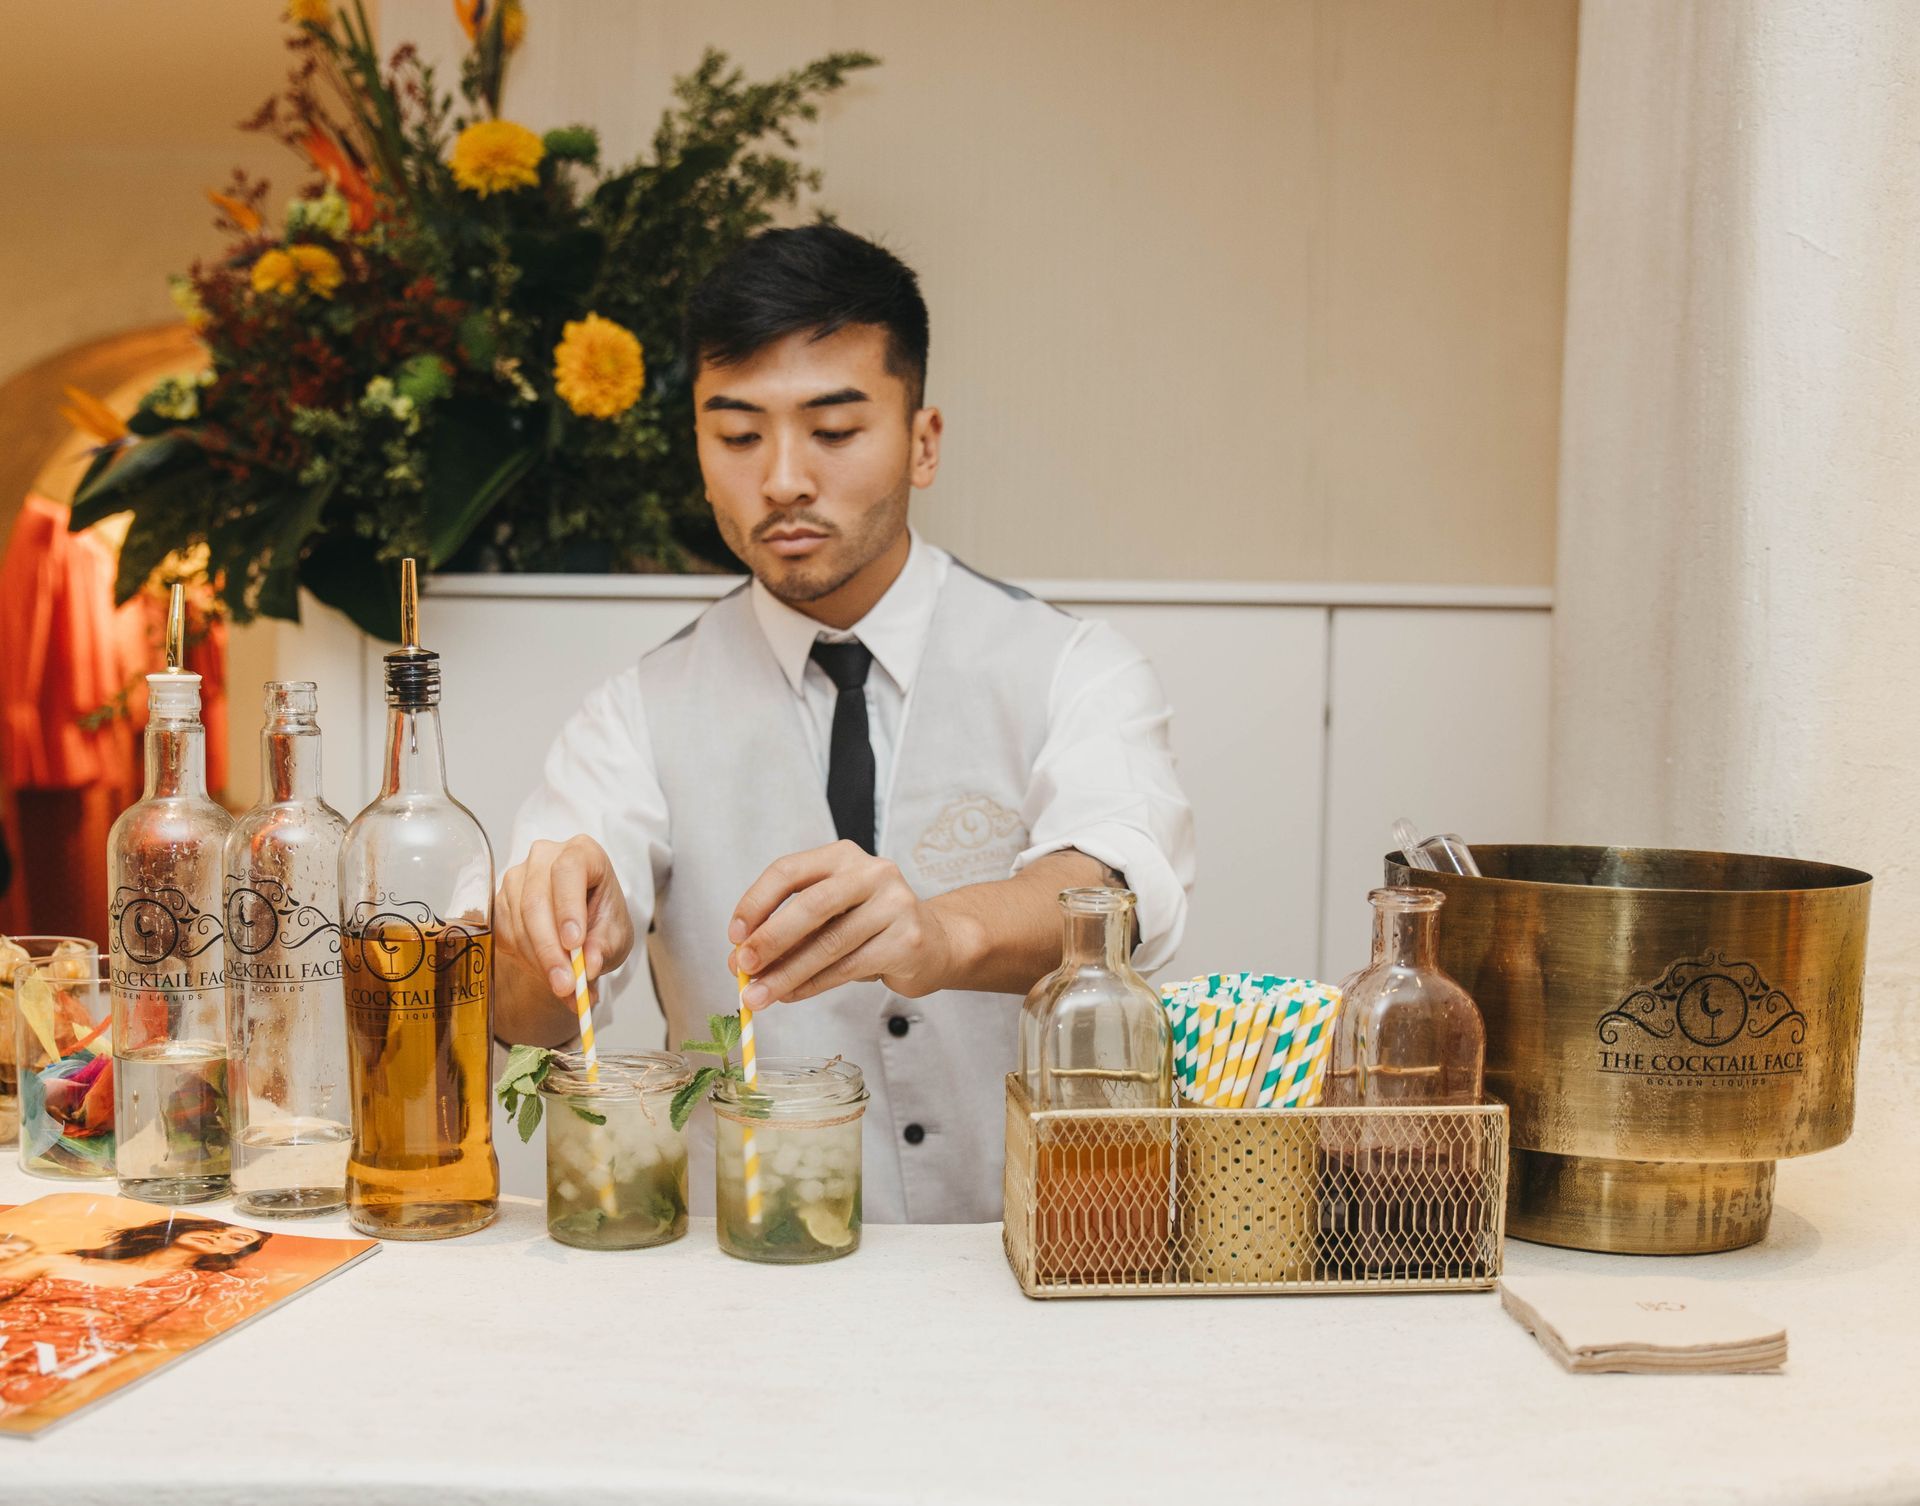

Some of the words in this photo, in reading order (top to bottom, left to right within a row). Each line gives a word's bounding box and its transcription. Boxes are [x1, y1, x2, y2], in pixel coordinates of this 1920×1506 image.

[111, 968, 193, 987] COCKTAIL
[226, 960, 294, 979] OCKTAIL
[149, 993, 203, 1002] LIQUIDS
[351, 988, 442, 1006] COCKTAIL
[448, 980, 485, 1002] FACE
[1599, 1051, 1644, 1069] THE
[1651, 1055, 1758, 1072] COCKTAIL
[1763, 1051, 1804, 1070] FACE
[1647, 1078, 1703, 1086] GOLDEN
[1712, 1078, 1766, 1087] LIQUIDS
